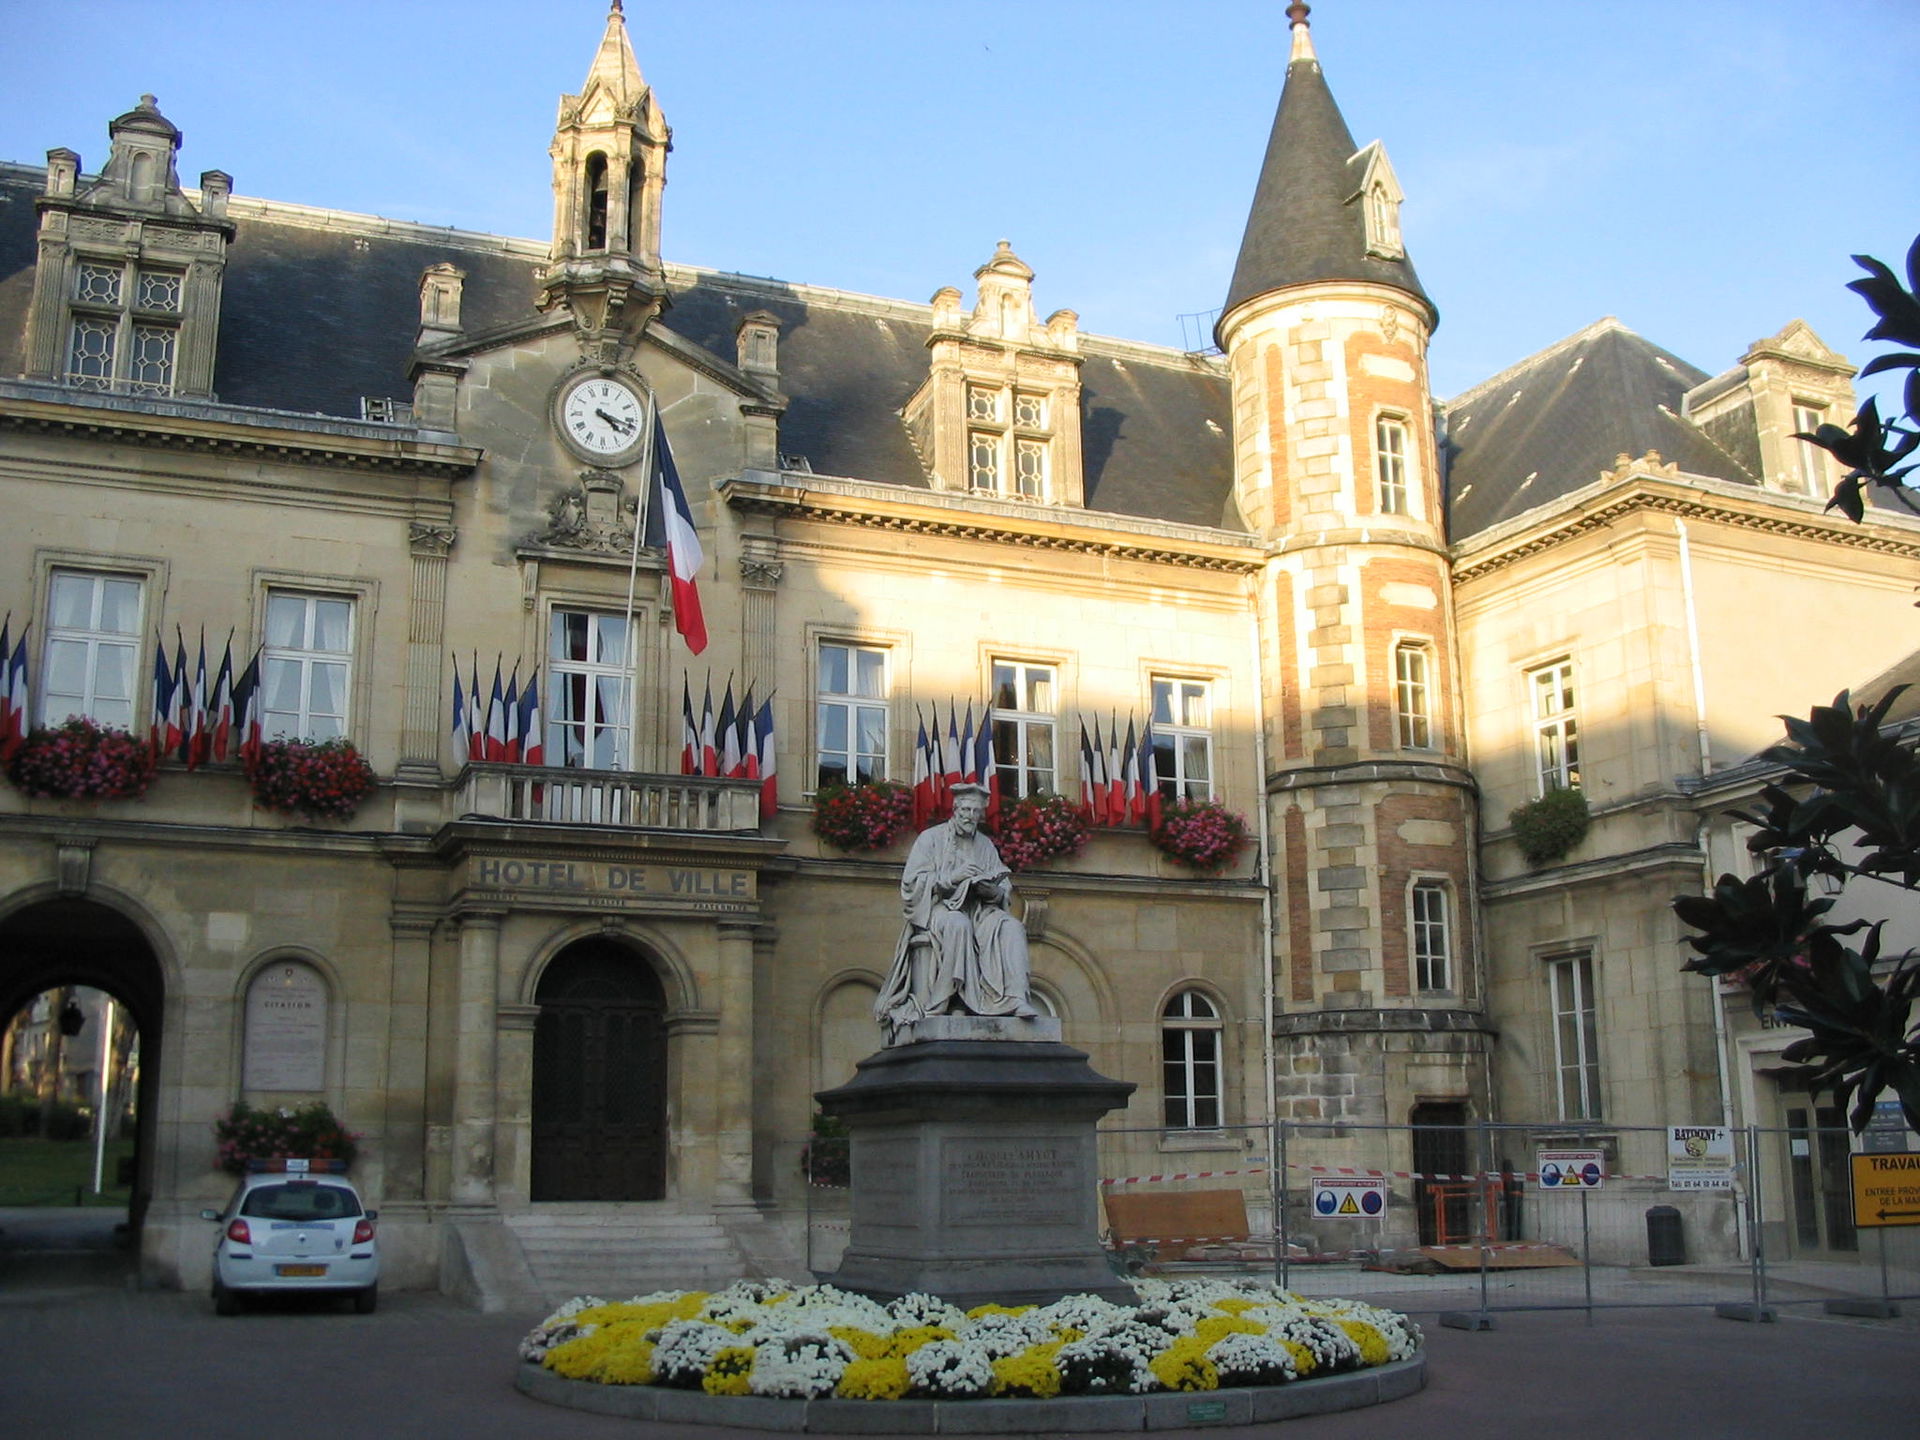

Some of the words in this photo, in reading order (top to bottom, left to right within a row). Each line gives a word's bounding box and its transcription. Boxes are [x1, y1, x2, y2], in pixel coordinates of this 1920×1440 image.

[480, 860, 584, 888] HOTEL
[608, 866, 646, 891] DE
[666, 869, 748, 896] VILLE
[264, 1001, 312, 1009] CITATION
[1898, 1186, 1920, 1195] PROV
